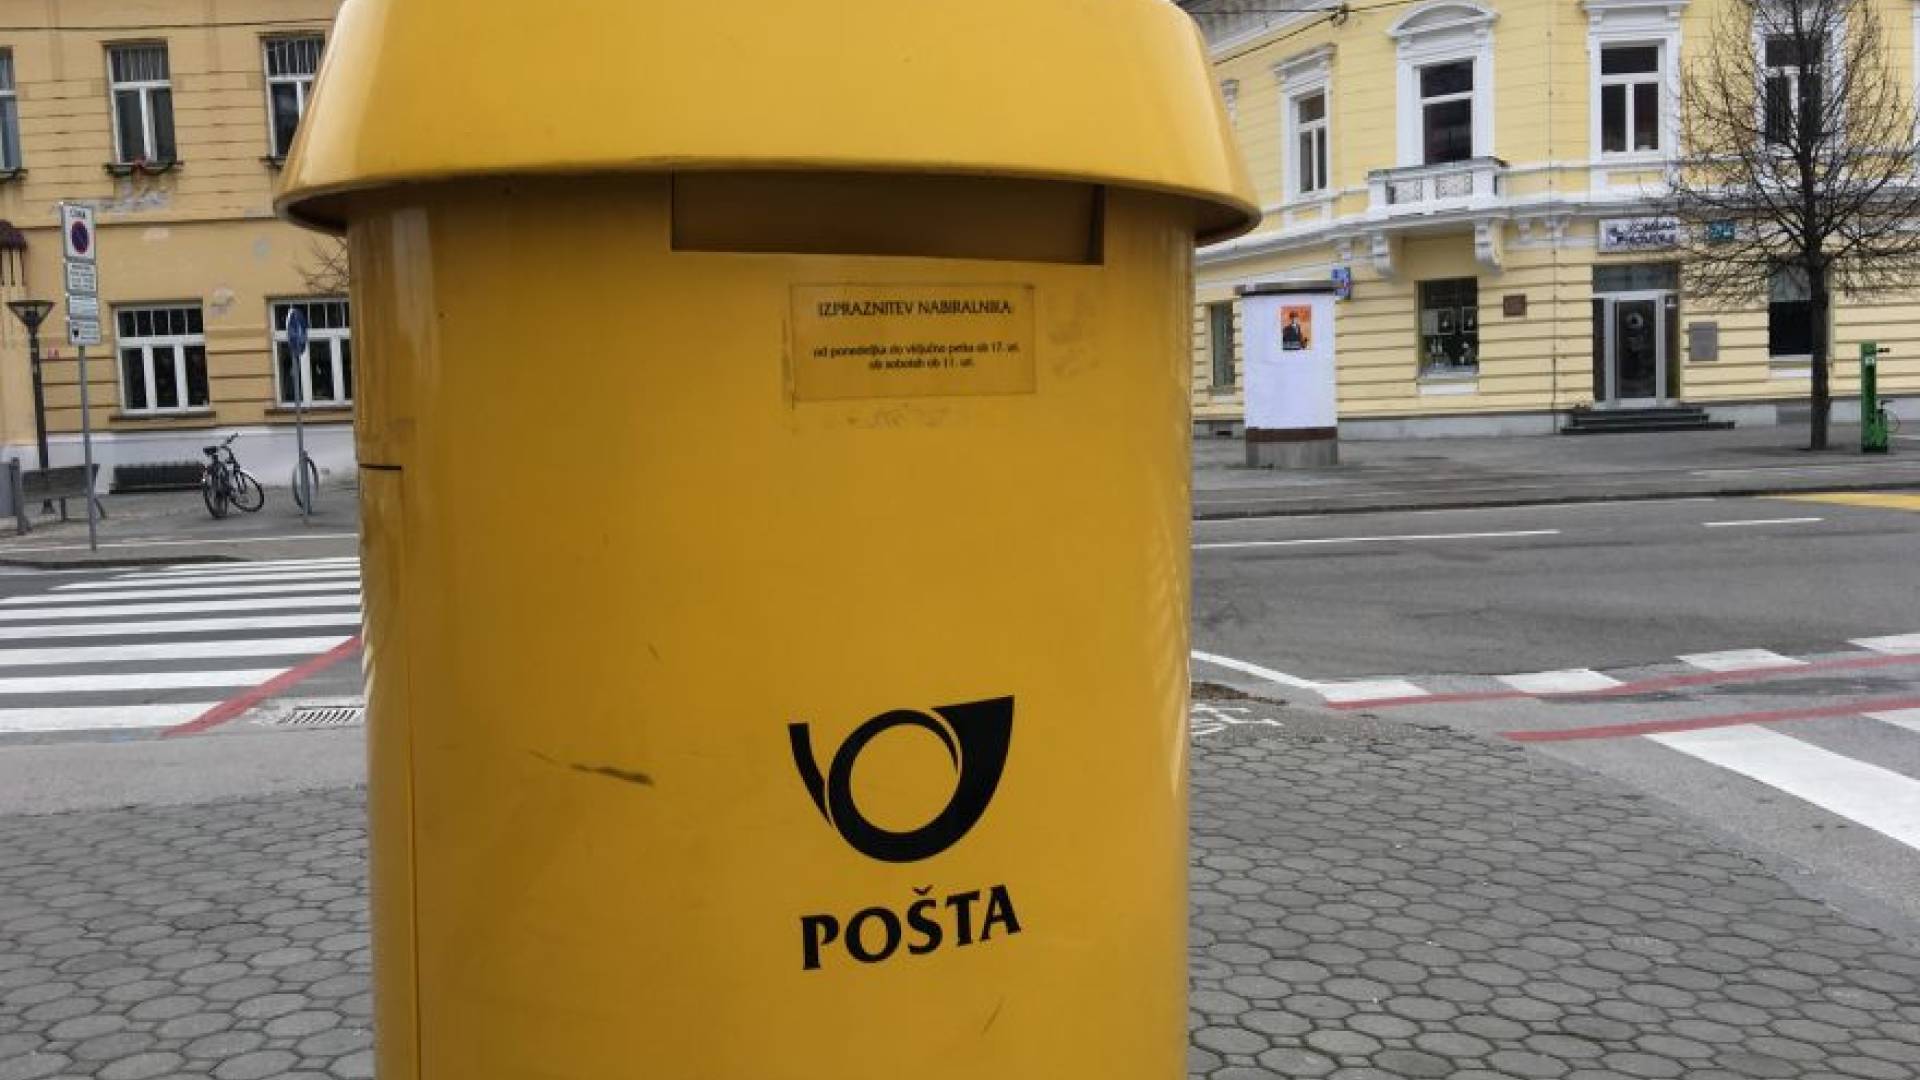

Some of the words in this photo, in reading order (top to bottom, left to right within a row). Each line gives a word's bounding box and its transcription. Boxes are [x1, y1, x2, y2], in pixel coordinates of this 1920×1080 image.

[817, 300, 913, 316] IZPRAZNITEV
[813, 345, 827, 358] od
[889, 344, 903, 354] do
[800, 884, 1021, 970] POŠTA
